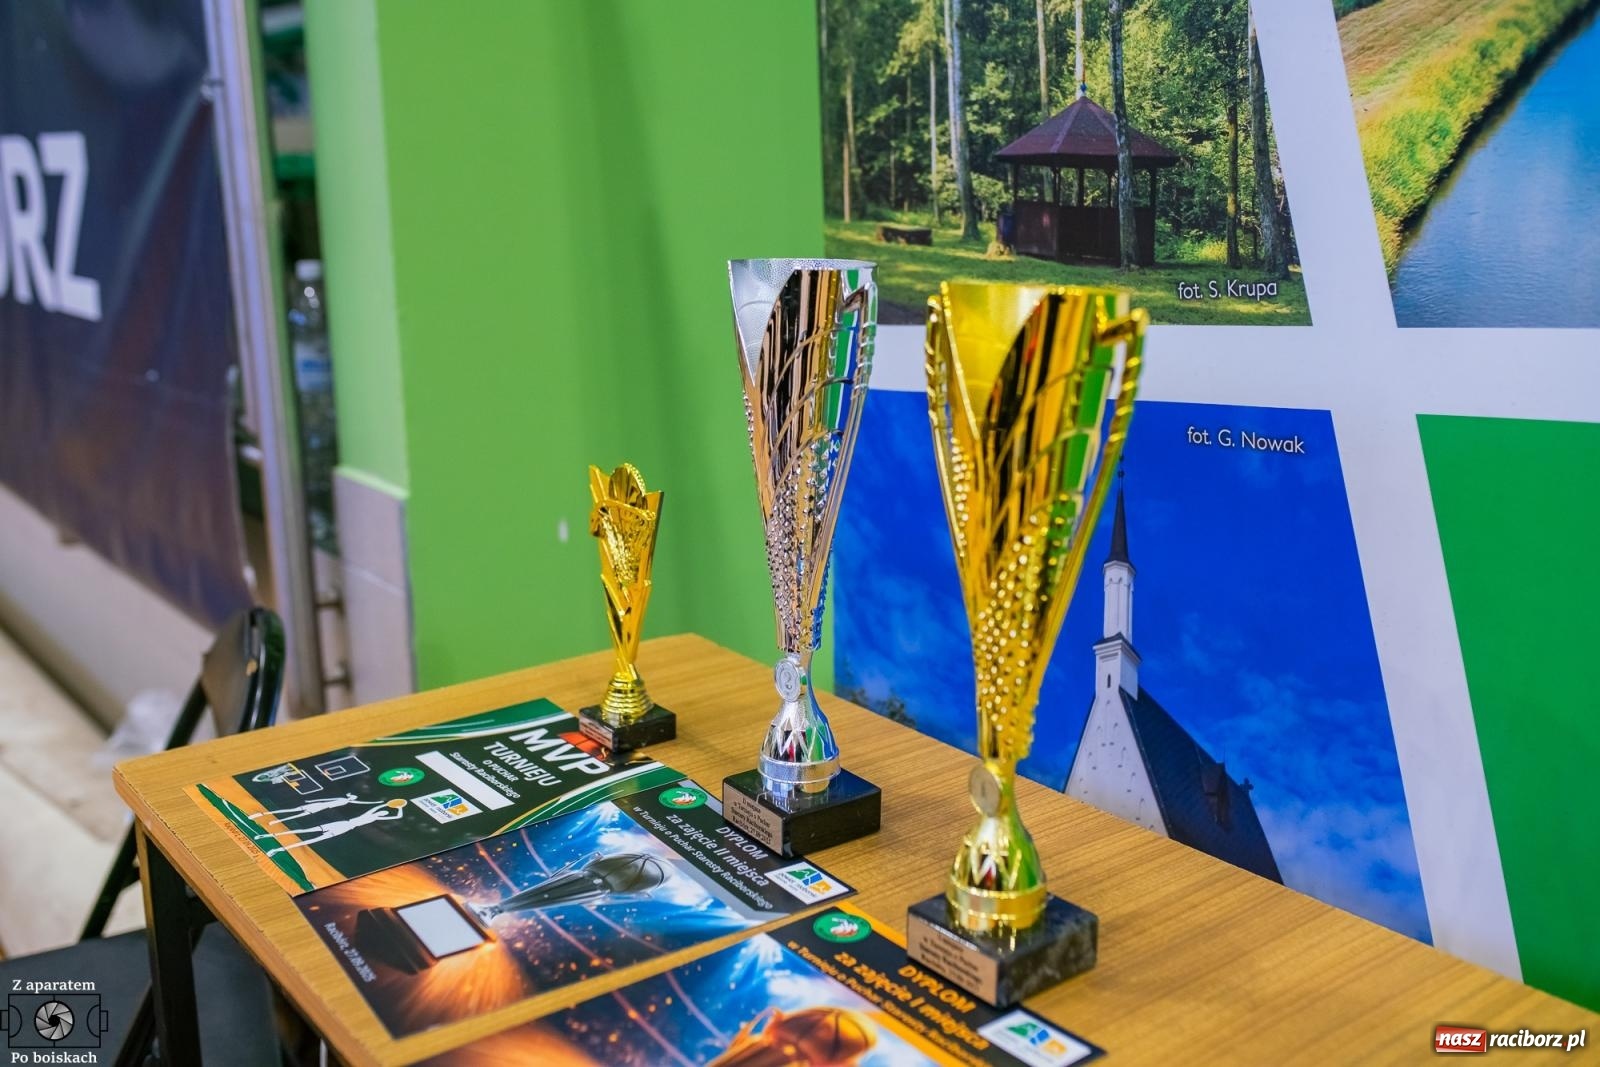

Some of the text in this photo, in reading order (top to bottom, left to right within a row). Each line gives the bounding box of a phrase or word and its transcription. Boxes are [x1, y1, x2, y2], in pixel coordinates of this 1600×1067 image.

[0, 130, 101, 322] RZ
[1177, 280, 1277, 301] fot. S. Krupa
[1187, 426, 1305, 455] fot. G. Nowak
[483, 741, 562, 787] TURNIEJU
[490, 763, 519, 783] PUCHAR
[508, 727, 611, 775] MVP
[640, 810, 667, 832] Turnieju
[670, 833, 696, 855] Puchar
[692, 850, 724, 873] Starosty
[720, 870, 774, 910] Raciborskiego
[665, 814, 683, 825] za
[678, 820, 718, 849] zajęcie
[723, 854, 770, 887] miejsca
[715, 826, 769, 860] DYPLOM
[897, 964, 977, 1014] DYPLOM
